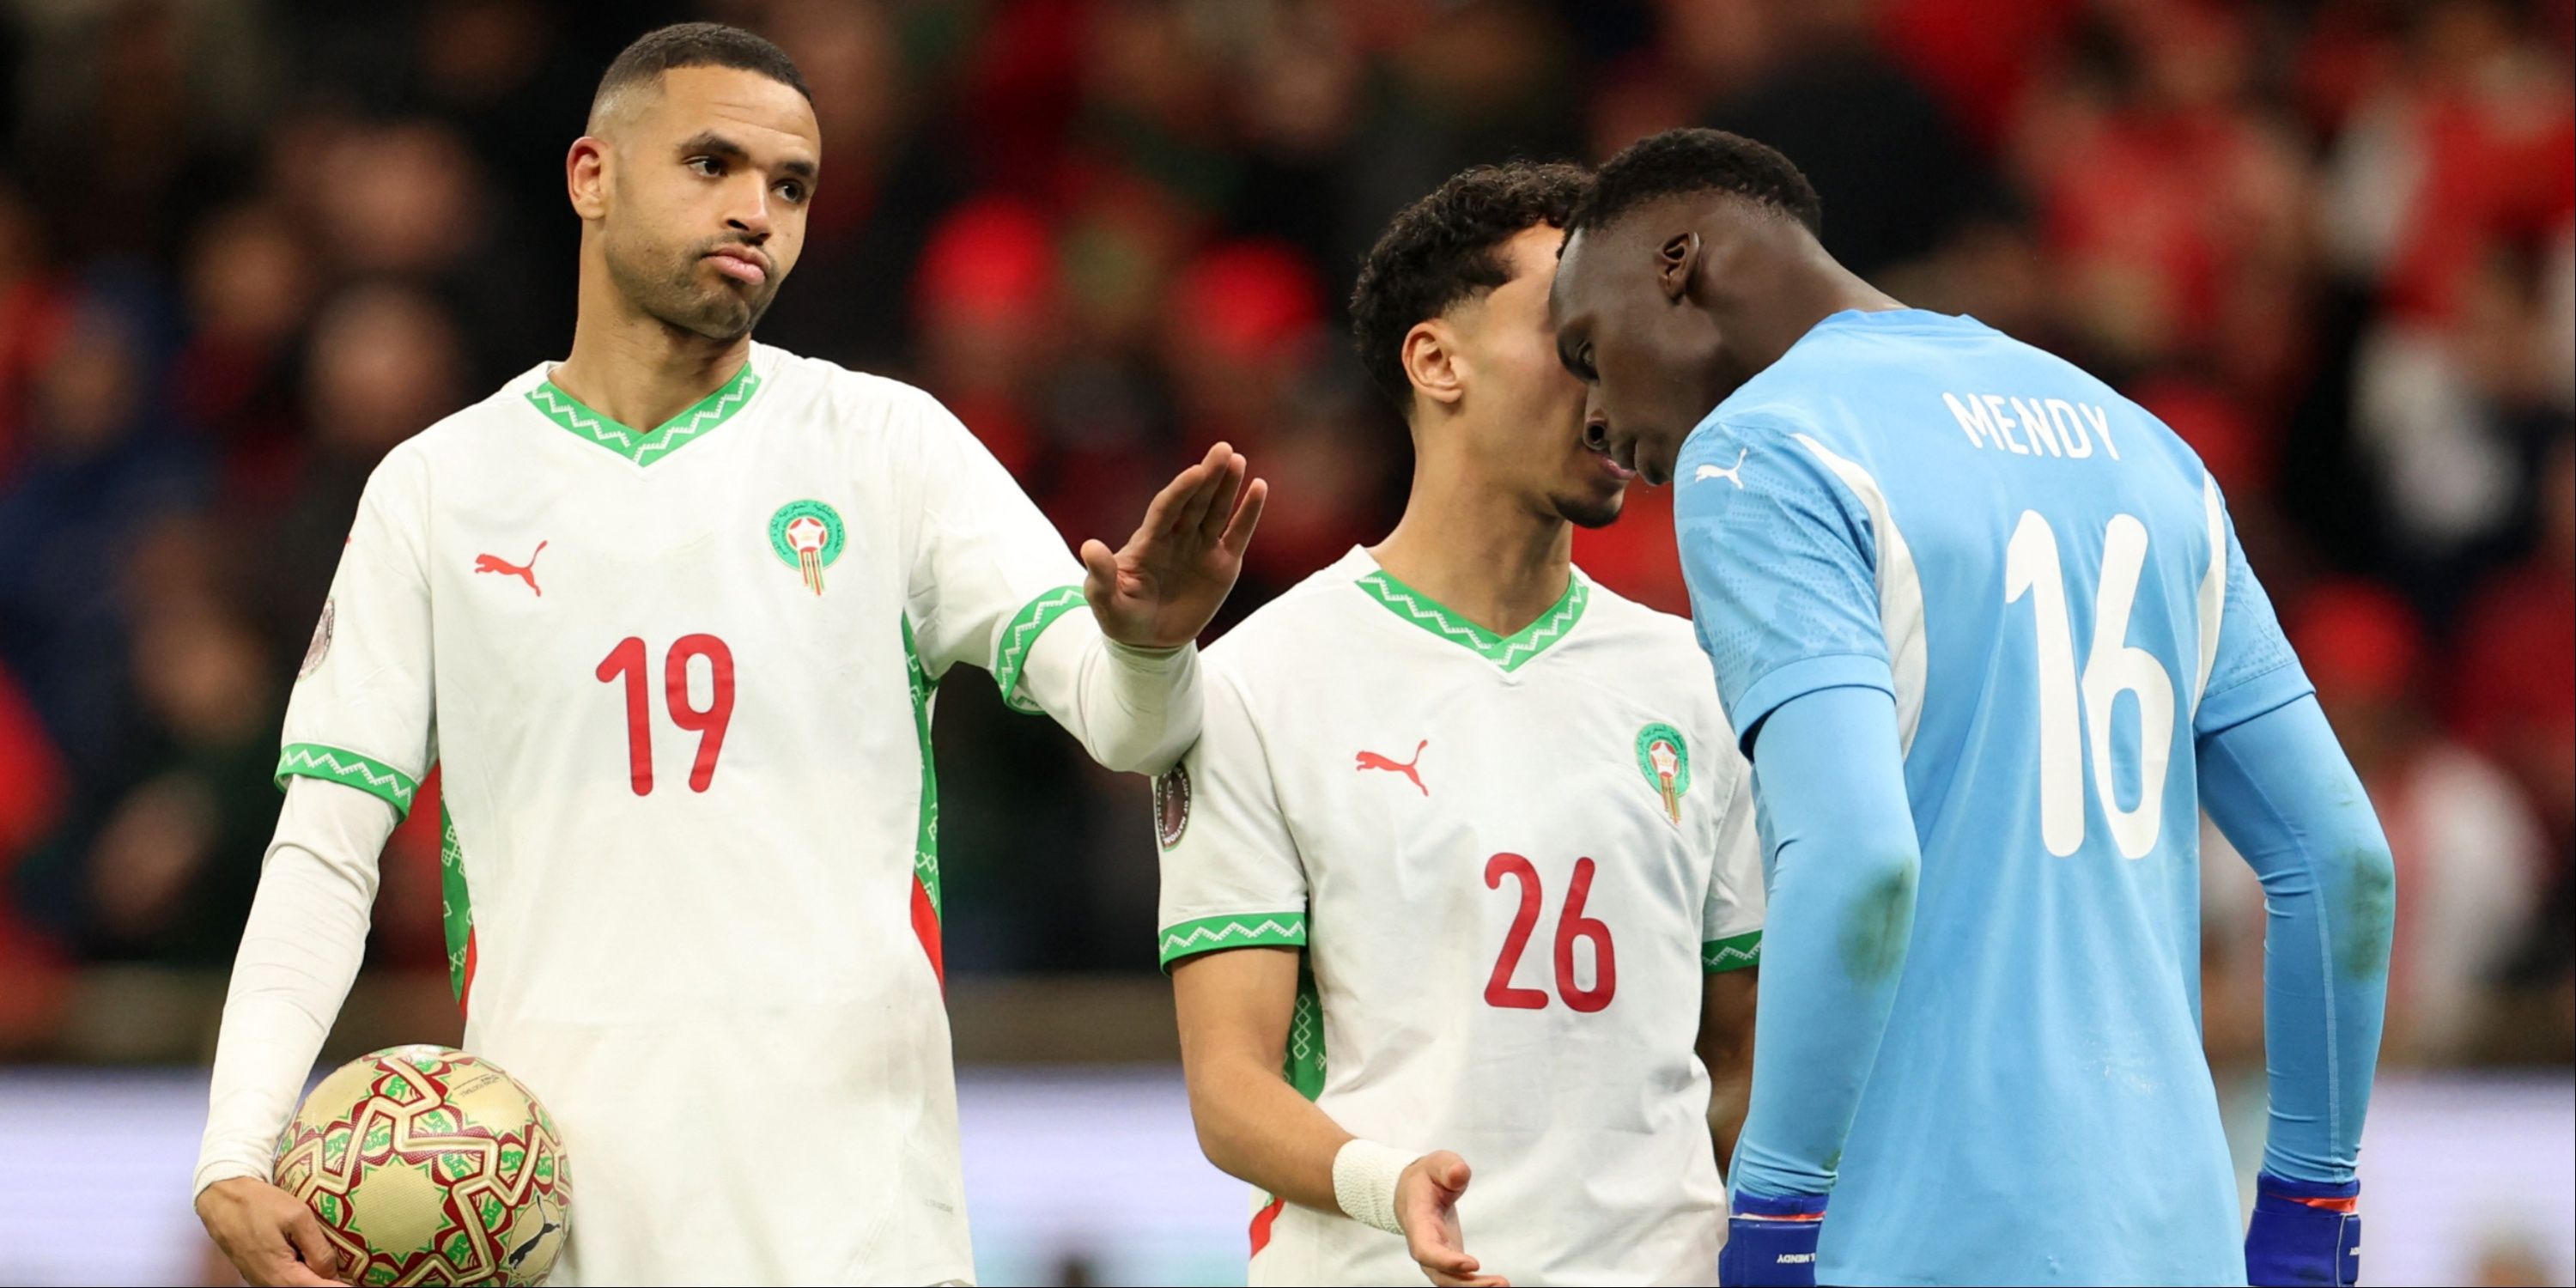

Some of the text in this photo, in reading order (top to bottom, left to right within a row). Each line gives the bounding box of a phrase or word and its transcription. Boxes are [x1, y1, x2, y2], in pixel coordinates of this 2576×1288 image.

[1941, 392, 2120, 461] MENDY
[595, 633, 736, 797] 19
[2005, 509, 2174, 860] 16
[1484, 852, 1617, 1013] 26
[1777, 1253, 1809, 1263] MENDY
